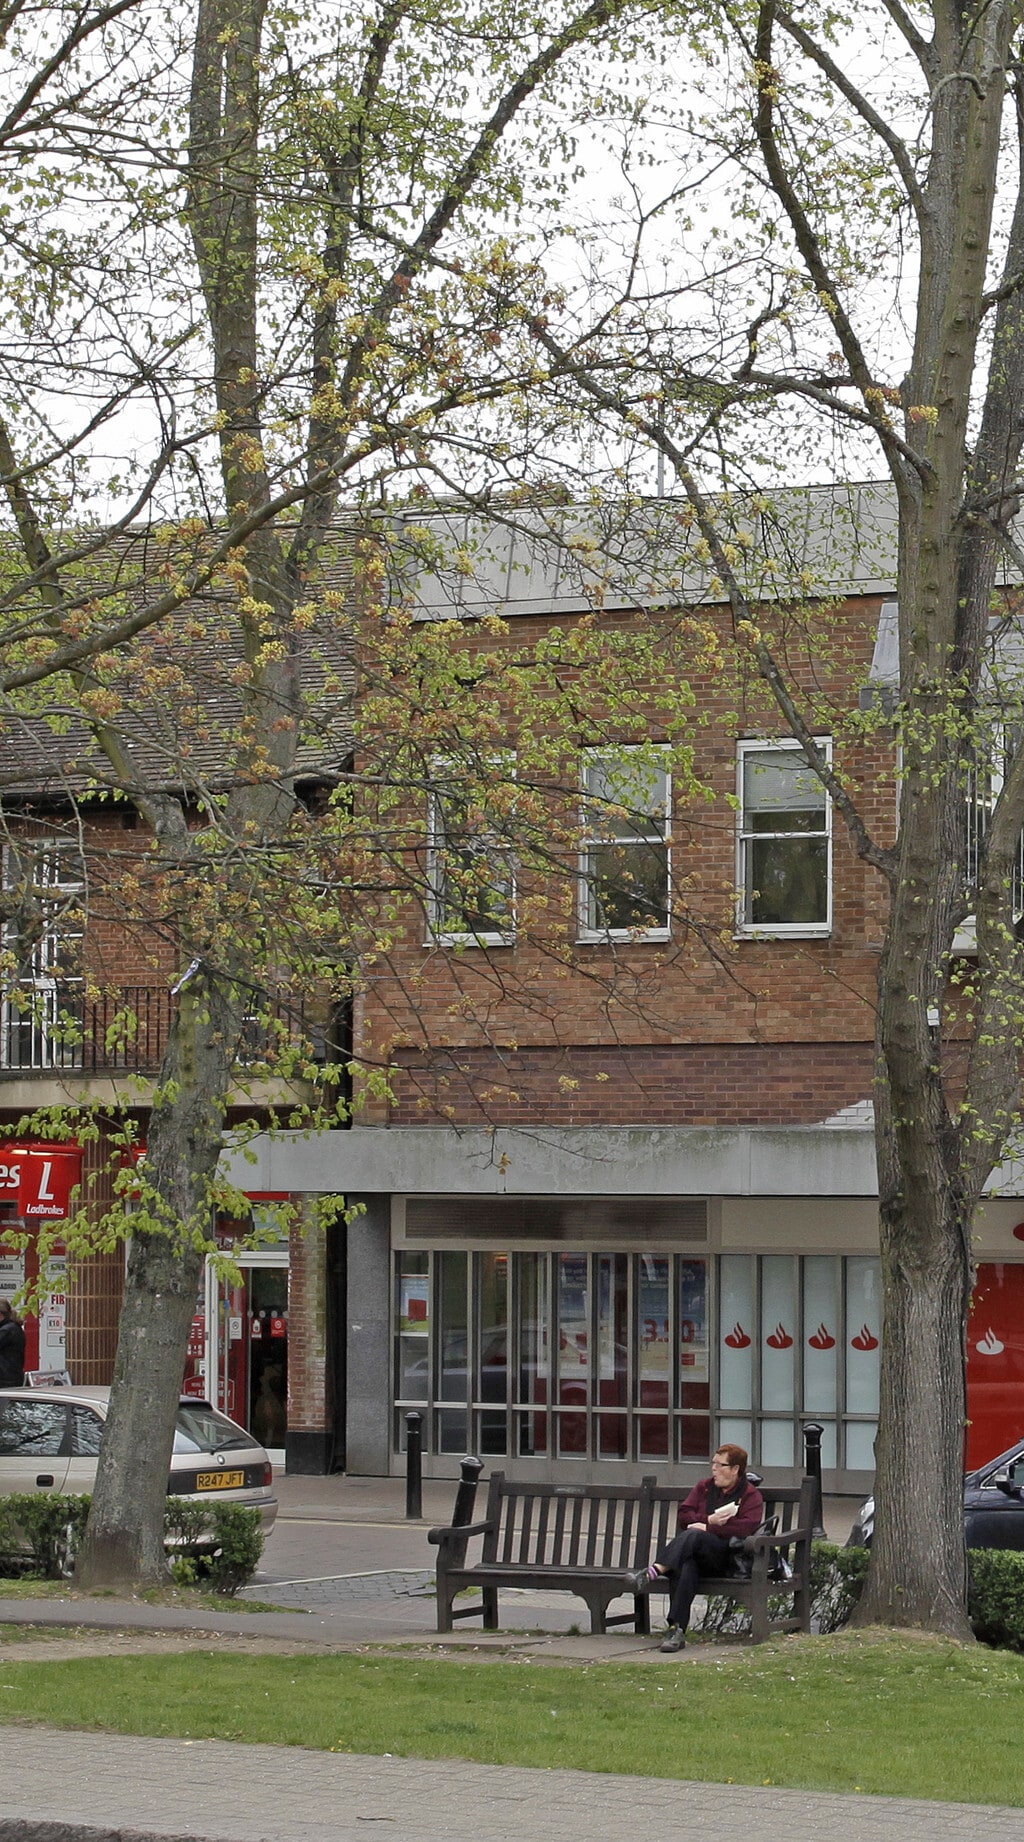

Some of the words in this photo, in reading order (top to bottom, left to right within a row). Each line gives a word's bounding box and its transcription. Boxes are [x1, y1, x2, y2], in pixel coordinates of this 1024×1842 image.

[38, 1161, 55, 1200] L
[26, 1203, 65, 1215] Ladbrokes
[198, 1474, 224, 1488] R247
[225, 1472, 243, 1485] JFT
